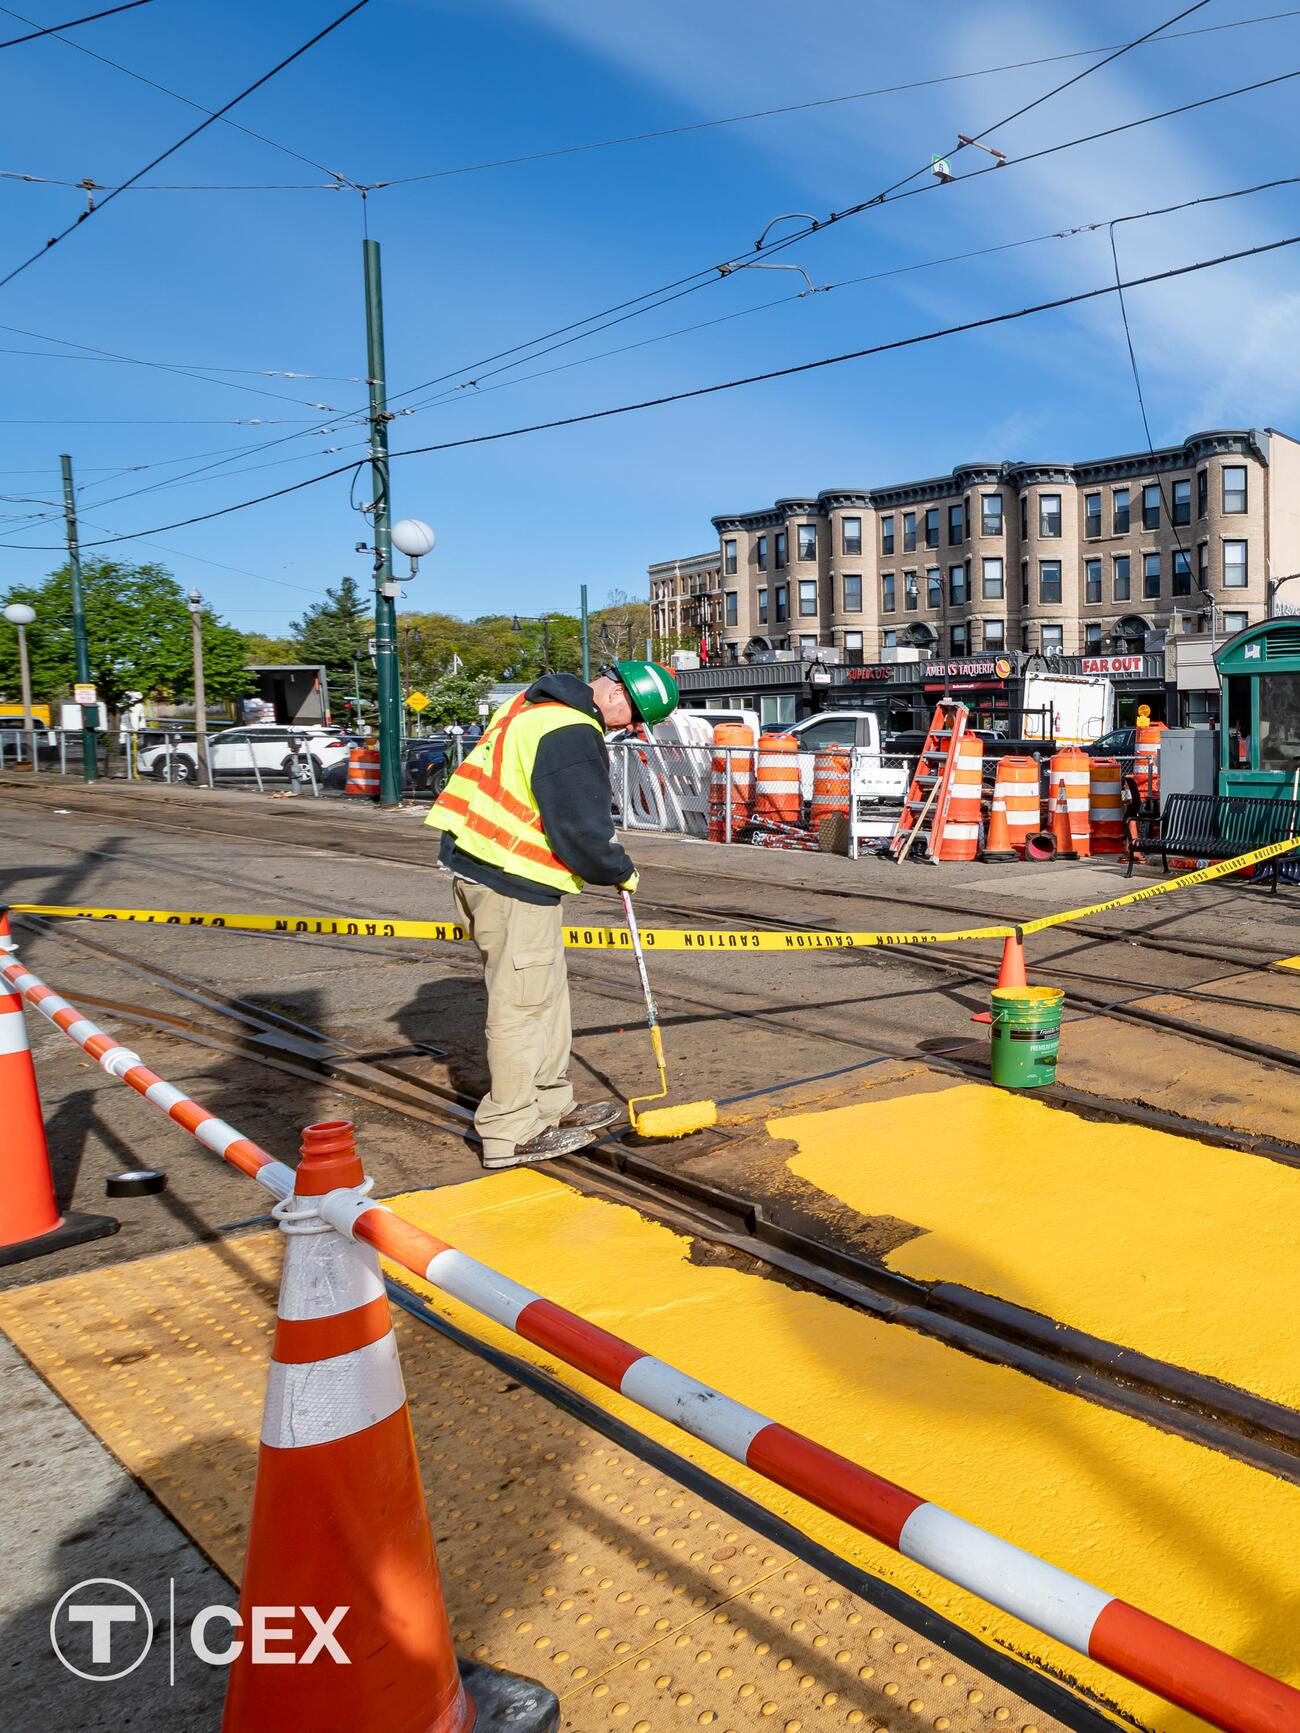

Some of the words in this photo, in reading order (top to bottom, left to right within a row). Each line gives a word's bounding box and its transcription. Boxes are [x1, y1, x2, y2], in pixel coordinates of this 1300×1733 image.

[958, 663, 995, 677] TAQUERIA
[1083, 659, 1110, 673] FAR
[1111, 657, 1142, 671] OUT
[275, 920, 395, 937] CAUTION
[570, 930, 655, 945] CUTION
[685, 934, 760, 947] CAUTION
[785, 935, 854, 947] CAUTION
